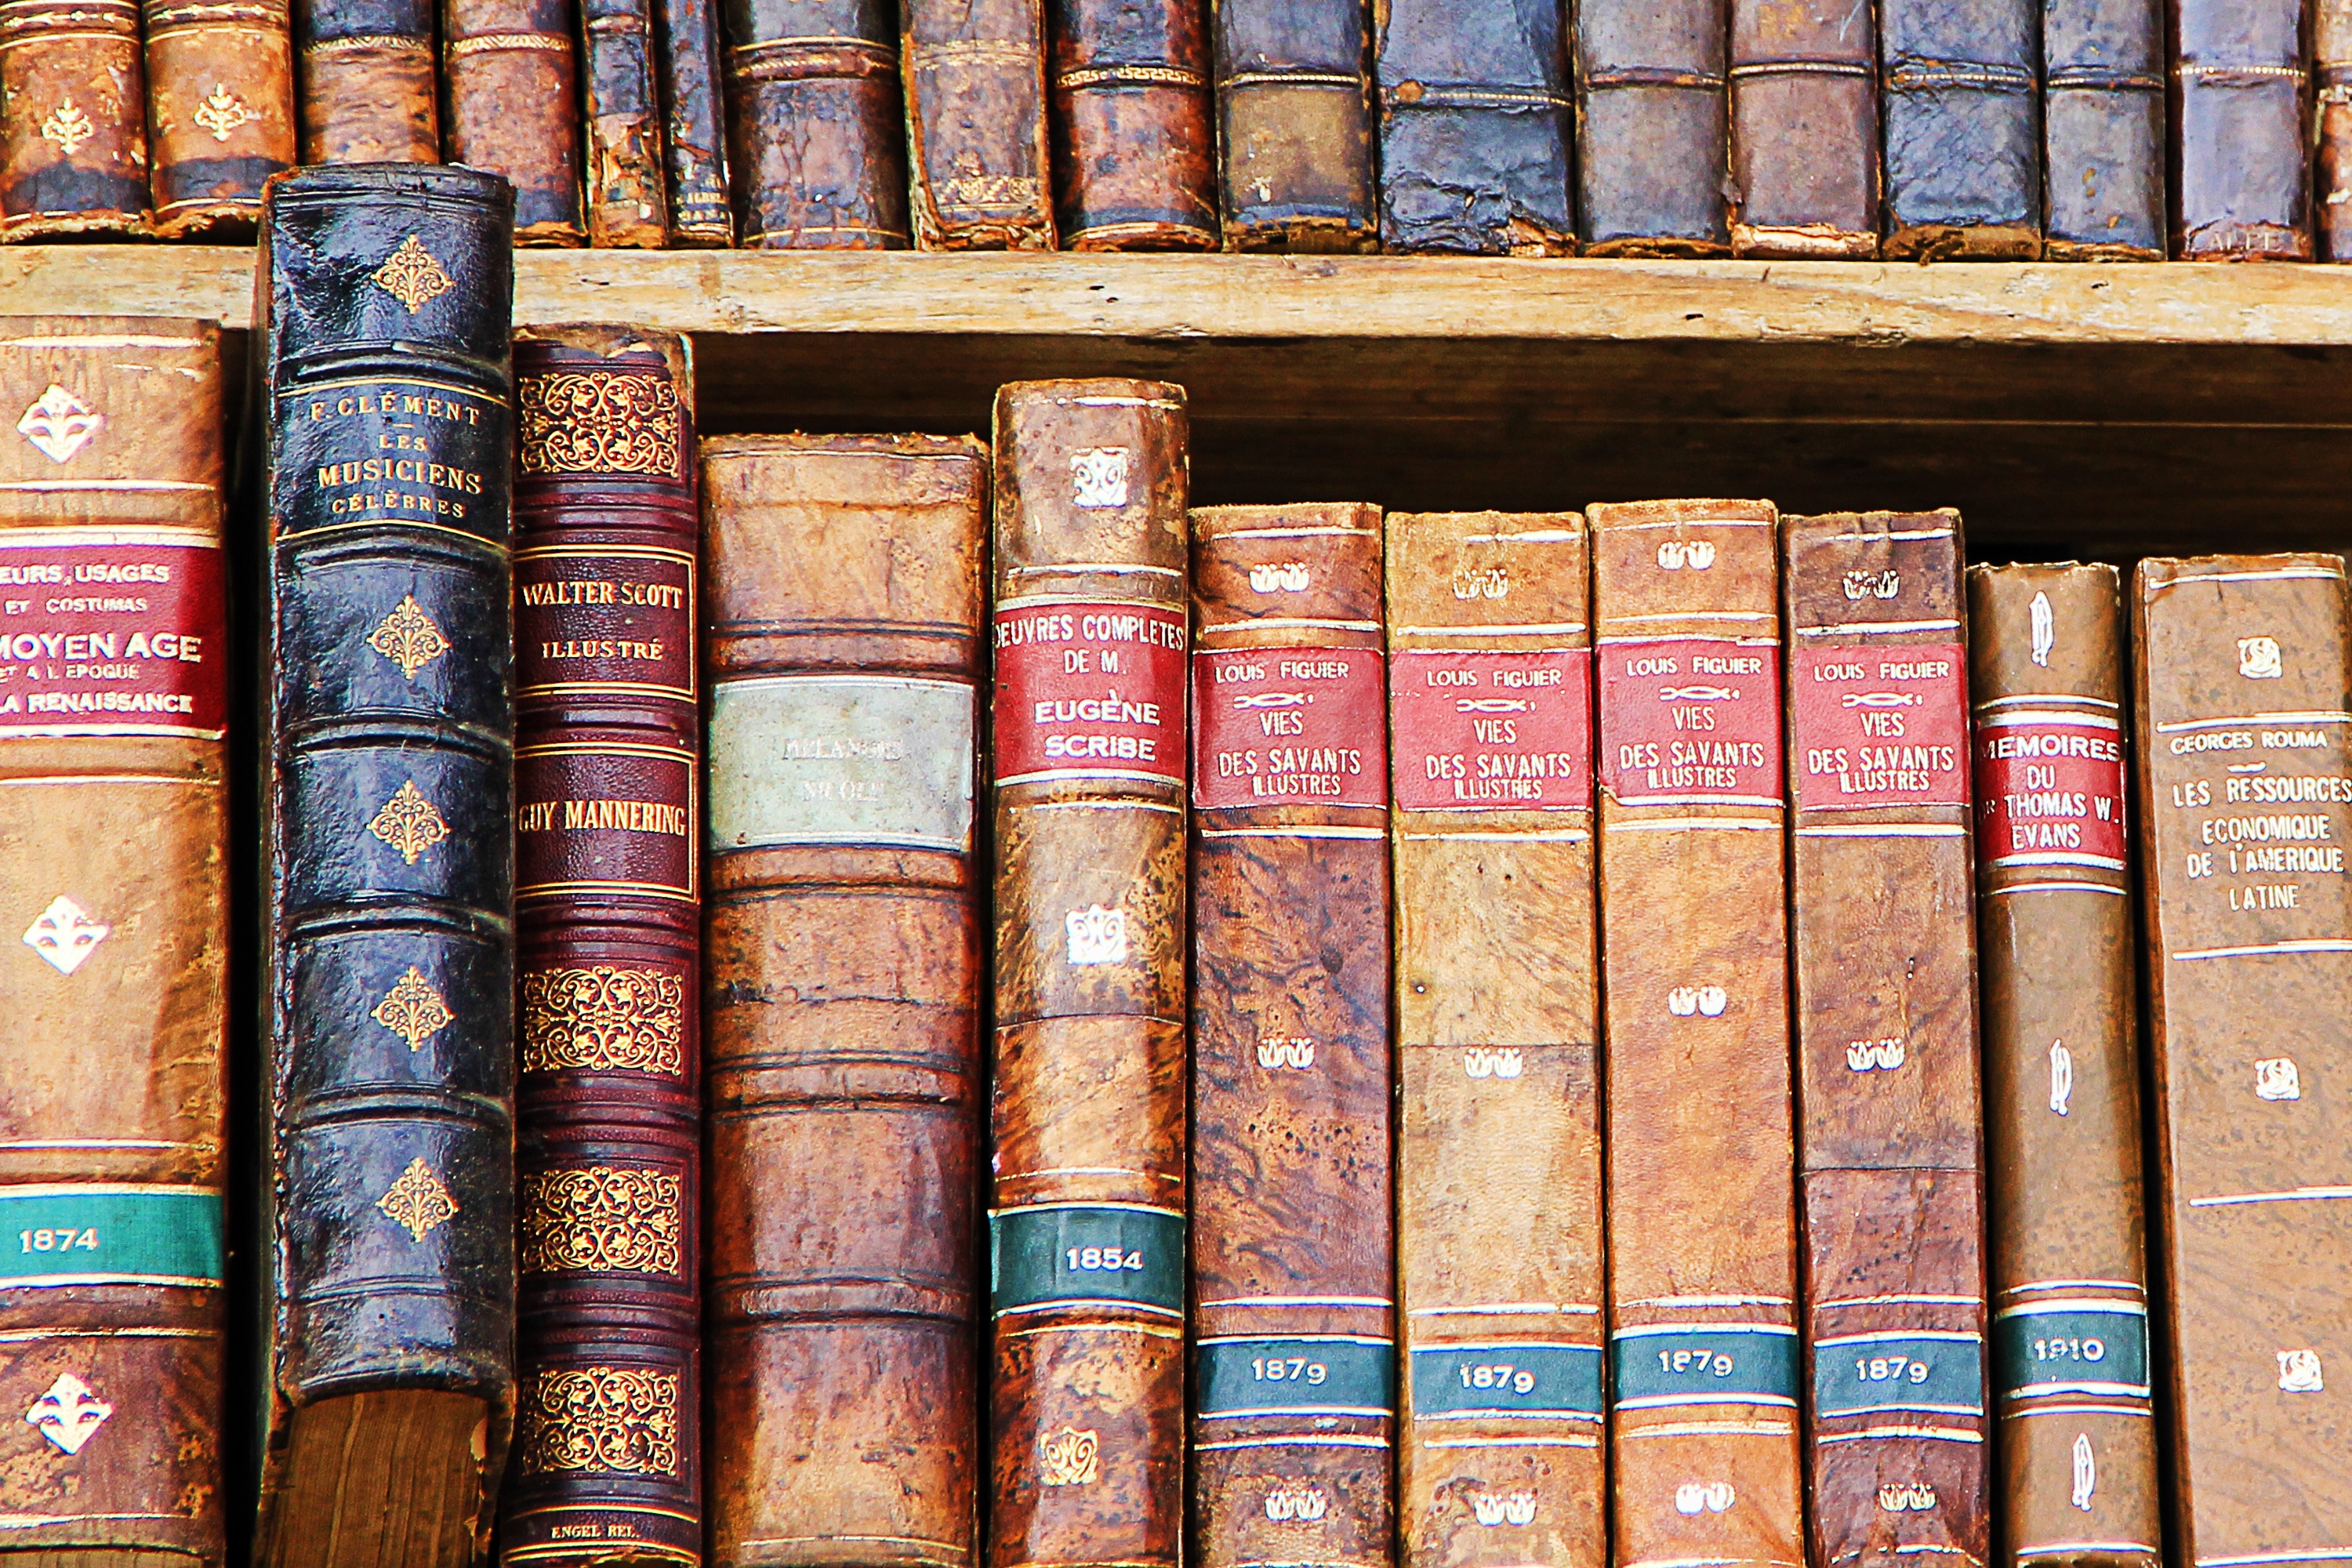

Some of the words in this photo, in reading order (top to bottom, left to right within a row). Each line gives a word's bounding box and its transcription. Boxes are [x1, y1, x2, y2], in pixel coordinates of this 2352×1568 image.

[337, 391, 480, 425] CLÉMENT
[379, 434, 428, 452] LES
[318, 457, 482, 495] MUSICIENS
[332, 489, 465, 518] CÉLÈBRES
[74, 563, 170, 584] USAGES
[5, 600, 31, 615] ET
[523, 581, 612, 606] WALTER
[620, 582, 683, 609] SCOTT
[124, 631, 202, 662] AGE
[1082, 615, 1185, 652] COMPLETES
[543, 638, 664, 660] ILLUSTRÉ
[1063, 649, 1090, 674] DE
[1101, 649, 1127, 674] M.
[66, 663, 140, 680] EPOQUE
[1215, 664, 1265, 684] LOUIS
[1279, 661, 1350, 680] FIGUIER
[1426, 670, 1479, 687] LOUIS
[1493, 669, 1563, 688] FIGUIER
[1626, 657, 1679, 677] LOUIS
[1692, 656, 1762, 675] FIGUIER
[1813, 663, 1866, 682] LOUIS
[1879, 661, 1950, 680] FIGUIER
[27, 691, 194, 713] RENAISSANCE
[1034, 688, 1161, 726] EUGÈNE
[1259, 710, 1304, 737] VIES
[1473, 719, 1517, 744] VIES
[1671, 706, 1715, 731] VIES
[1860, 711, 1905, 738] VIES
[1044, 735, 1157, 762] SCRIBE
[1619, 742, 1661, 770] DES
[1670, 740, 1765, 768] SAVANTS
[1983, 734, 2121, 762] MEMOIRES
[2170, 731, 2254, 755] GEORGES
[2260, 730, 2328, 748] ROUMA
[1218, 750, 1258, 778] DES
[1269, 747, 1362, 775] SAVANTS
[1425, 754, 1467, 780] DES
[1476, 753, 1572, 779] SAVANTS
[1808, 747, 1849, 775] DES
[1859, 745, 1955, 772] SAVANTS
[1252, 773, 1342, 797] ILLUSTRES
[1454, 779, 1543, 800] ILLUSTRES
[1647, 765, 1737, 789] ILLUSTRES
[1839, 770, 1930, 794] ILLUSTRES
[2026, 764, 2056, 790] DU
[2172, 780, 2212, 808] LES
[2226, 776, 2352, 804] RESSOURCES
[518, 800, 557, 833] GUY
[564, 799, 686, 837] MANNERING
[2003, 792, 2087, 819] THOMAS
[2093, 795, 2120, 824] W.
[2011, 823, 2082, 851] EVANS
[2201, 814, 2332, 845] ECONOMIQUE
[2187, 851, 2213, 879] DE
[2229, 884, 2299, 911] LATINE
[19, 1227, 99, 1254] 1874
[1065, 1247, 1144, 1272] 1854
[1251, 1356, 1328, 1386] 1879
[1658, 1348, 1733, 1377] 1879
[1856, 1355, 1929, 1385] 1879
[1459, 1361, 1536, 1396] 1879
[551, 1525, 601, 1539] ENGEL
